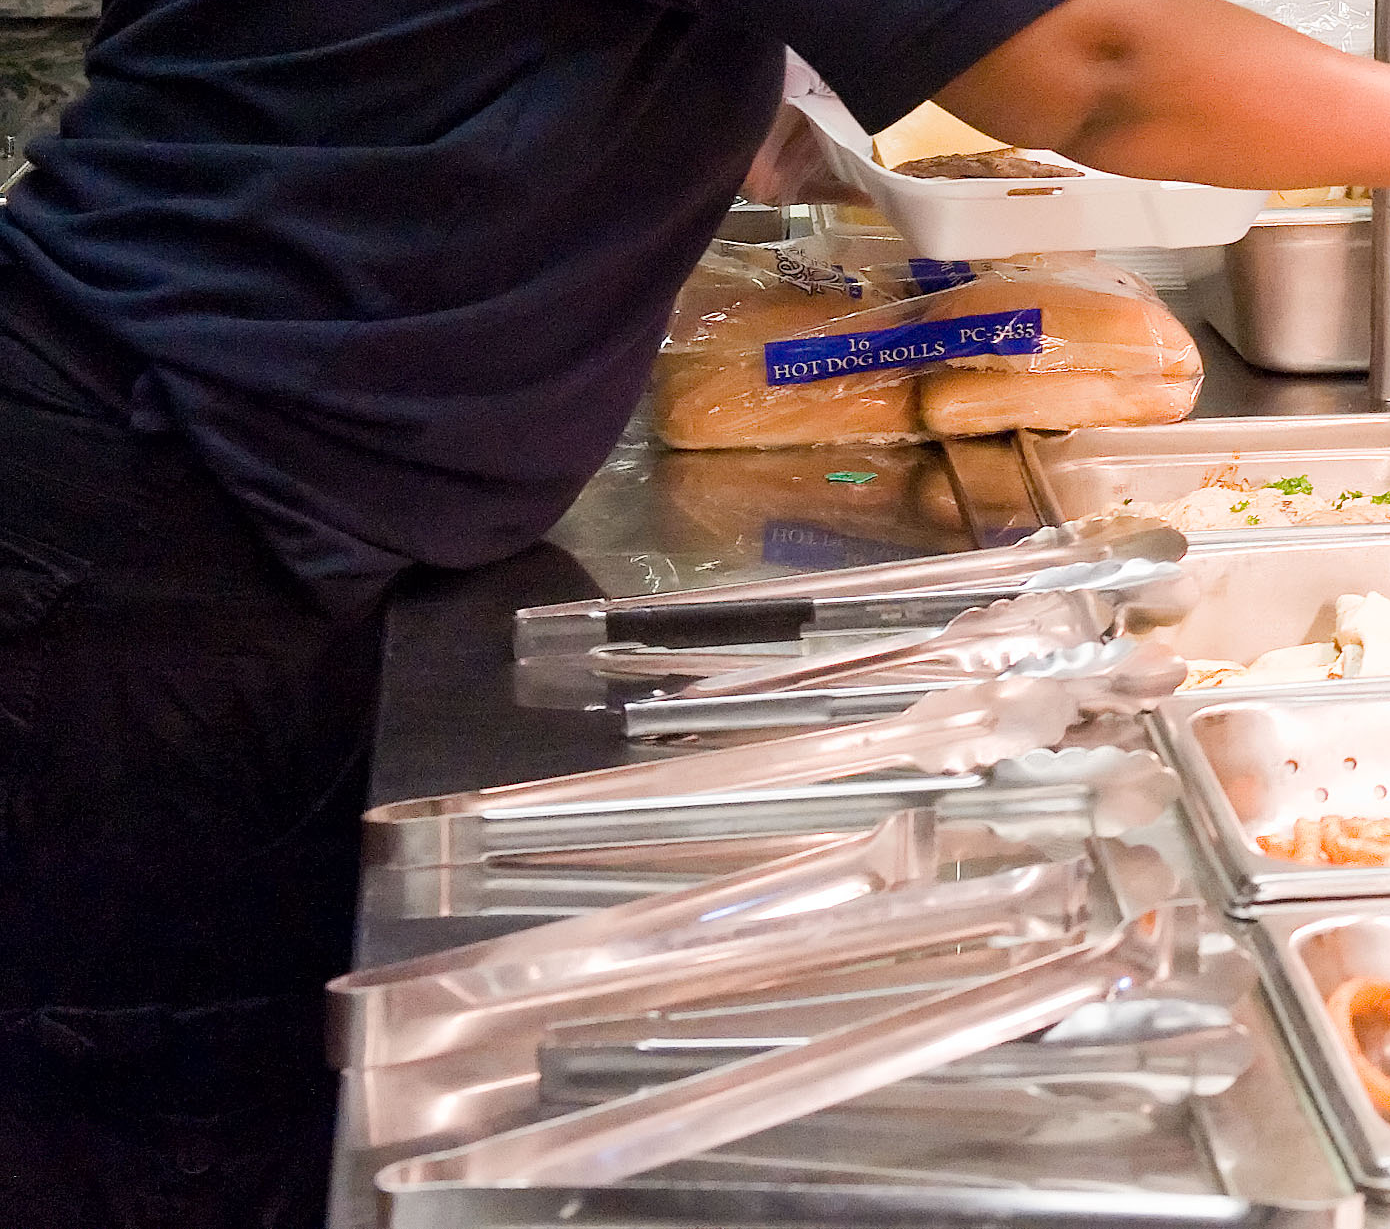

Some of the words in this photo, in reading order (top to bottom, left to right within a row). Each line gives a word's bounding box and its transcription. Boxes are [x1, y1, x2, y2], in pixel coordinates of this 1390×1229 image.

[960, 323, 1035, 344] PC-3435
[848, 338, 870, 352] 16
[773, 360, 821, 379] HOT
[826, 353, 873, 372] DOG
[879, 340, 946, 363] ROLLS
